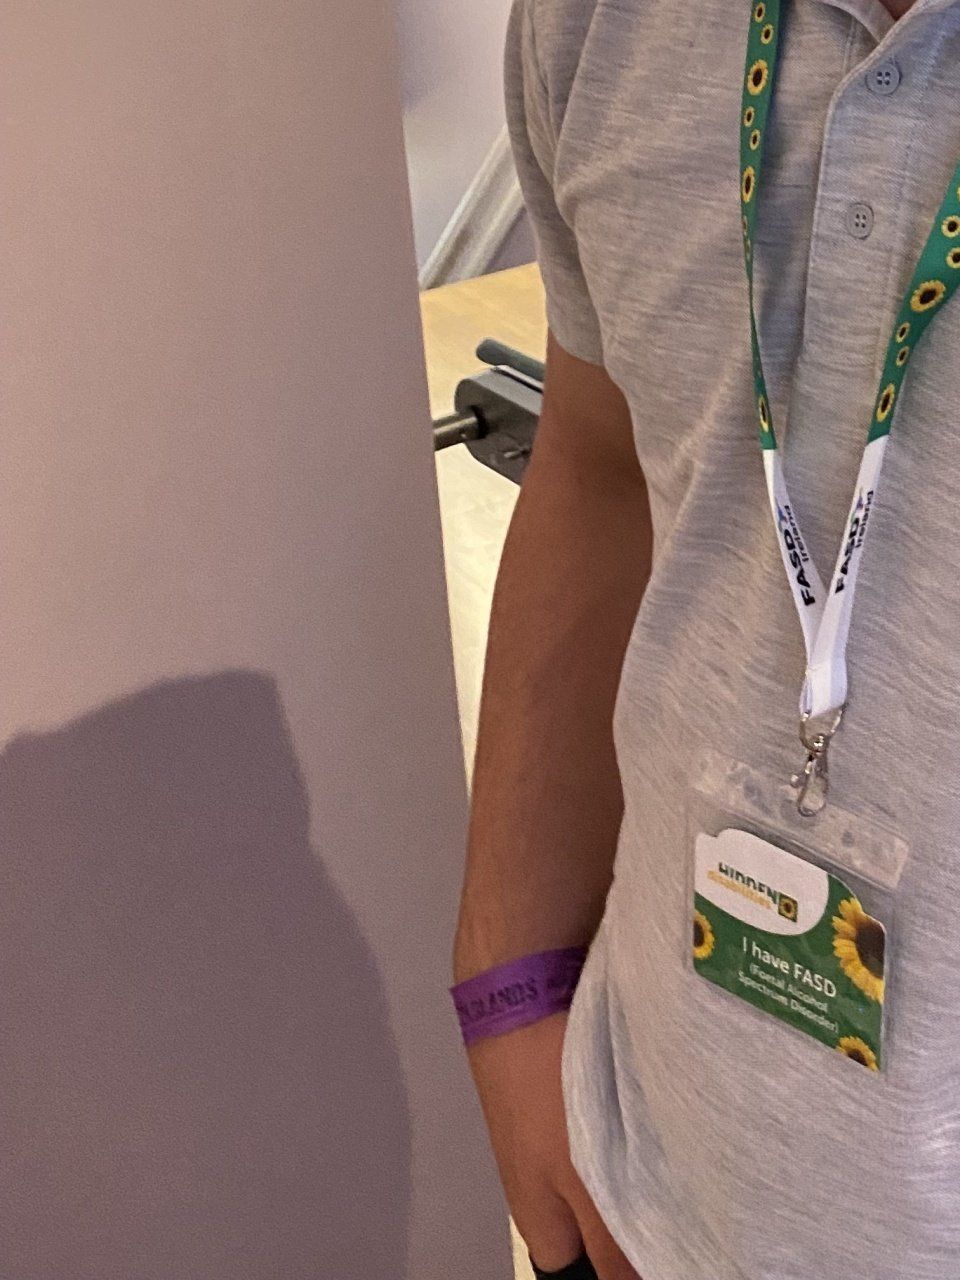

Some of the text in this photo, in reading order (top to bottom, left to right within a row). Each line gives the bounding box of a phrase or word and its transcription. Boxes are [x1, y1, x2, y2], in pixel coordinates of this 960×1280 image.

[783, 528, 816, 606] FASD
[742, 936, 837, 998] I have FASD
